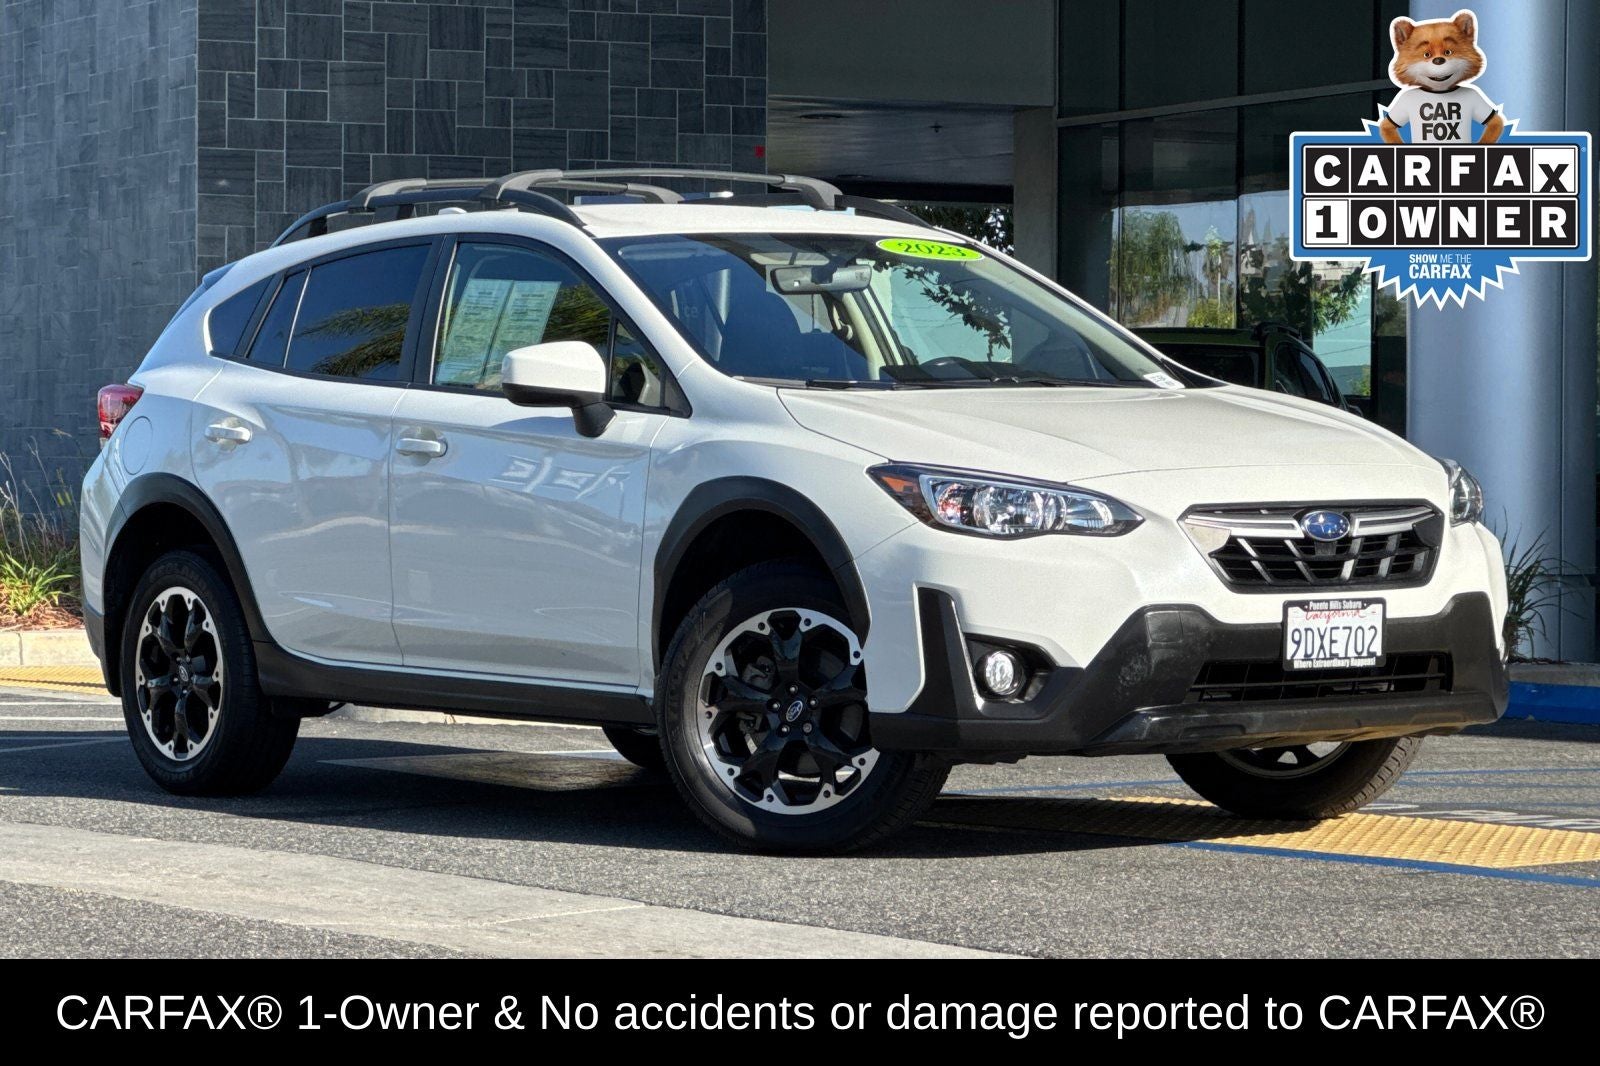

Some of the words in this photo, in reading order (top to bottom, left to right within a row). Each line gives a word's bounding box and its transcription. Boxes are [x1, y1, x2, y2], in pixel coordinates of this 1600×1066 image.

[897, 242, 967, 257] 2023
[1309, 601, 1329, 611] Puente
[1342, 599, 1362, 610] Subaru
[1290, 624, 1378, 660] 9DXE702
[1293, 659, 1313, 669] Where
